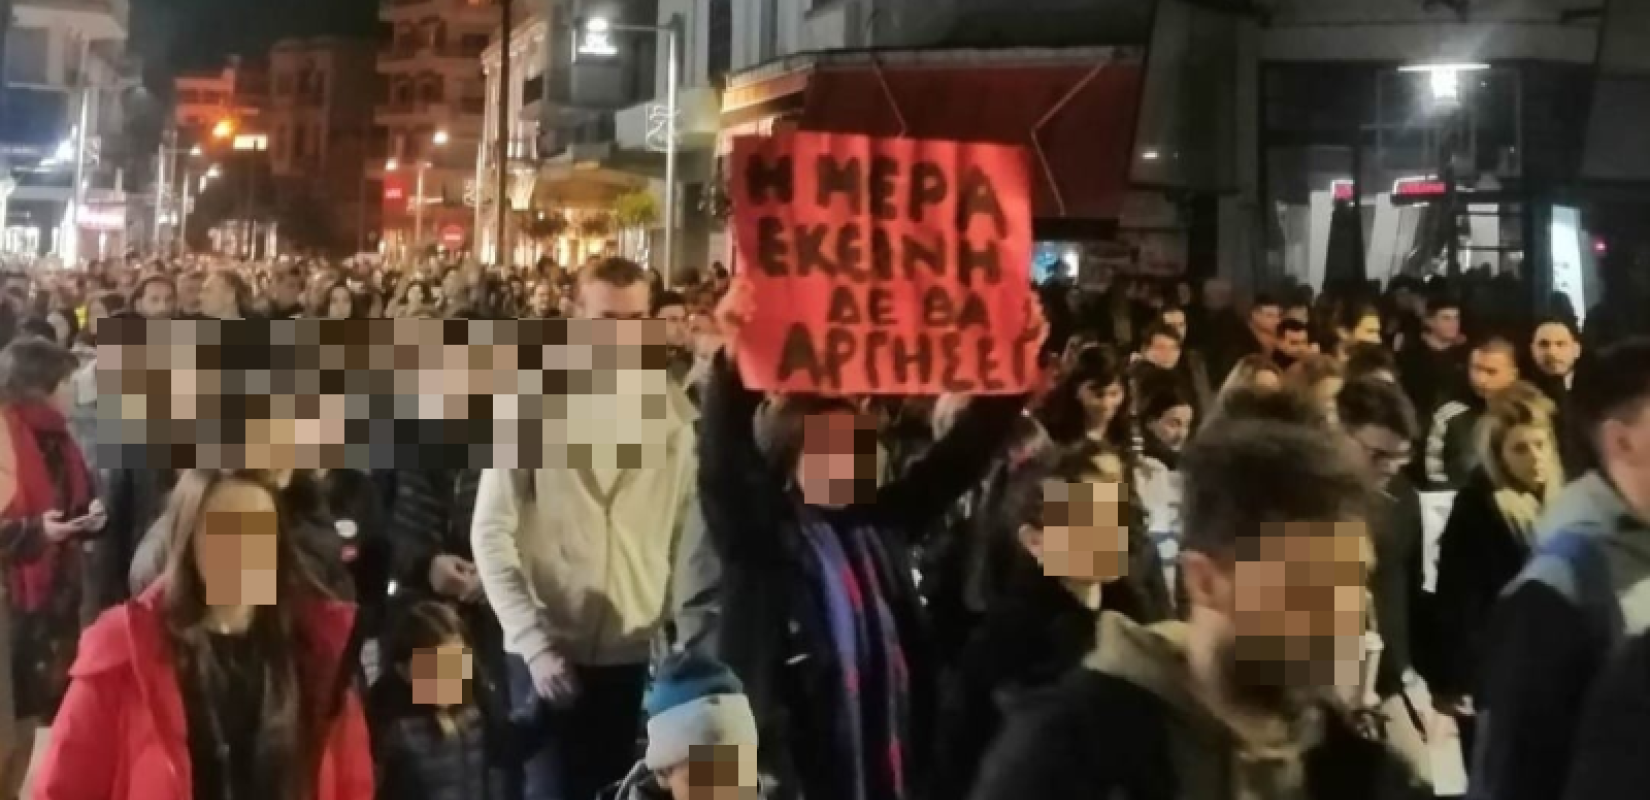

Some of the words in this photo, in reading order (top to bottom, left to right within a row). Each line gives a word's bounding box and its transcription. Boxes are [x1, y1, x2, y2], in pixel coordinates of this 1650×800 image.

[745, 154, 795, 207] Η
[815, 154, 1008, 240] ΜΕΡΑ
[757, 215, 1001, 288] ΕΚΕΙΝΗ
[828, 285, 898, 326] ΔΕ
